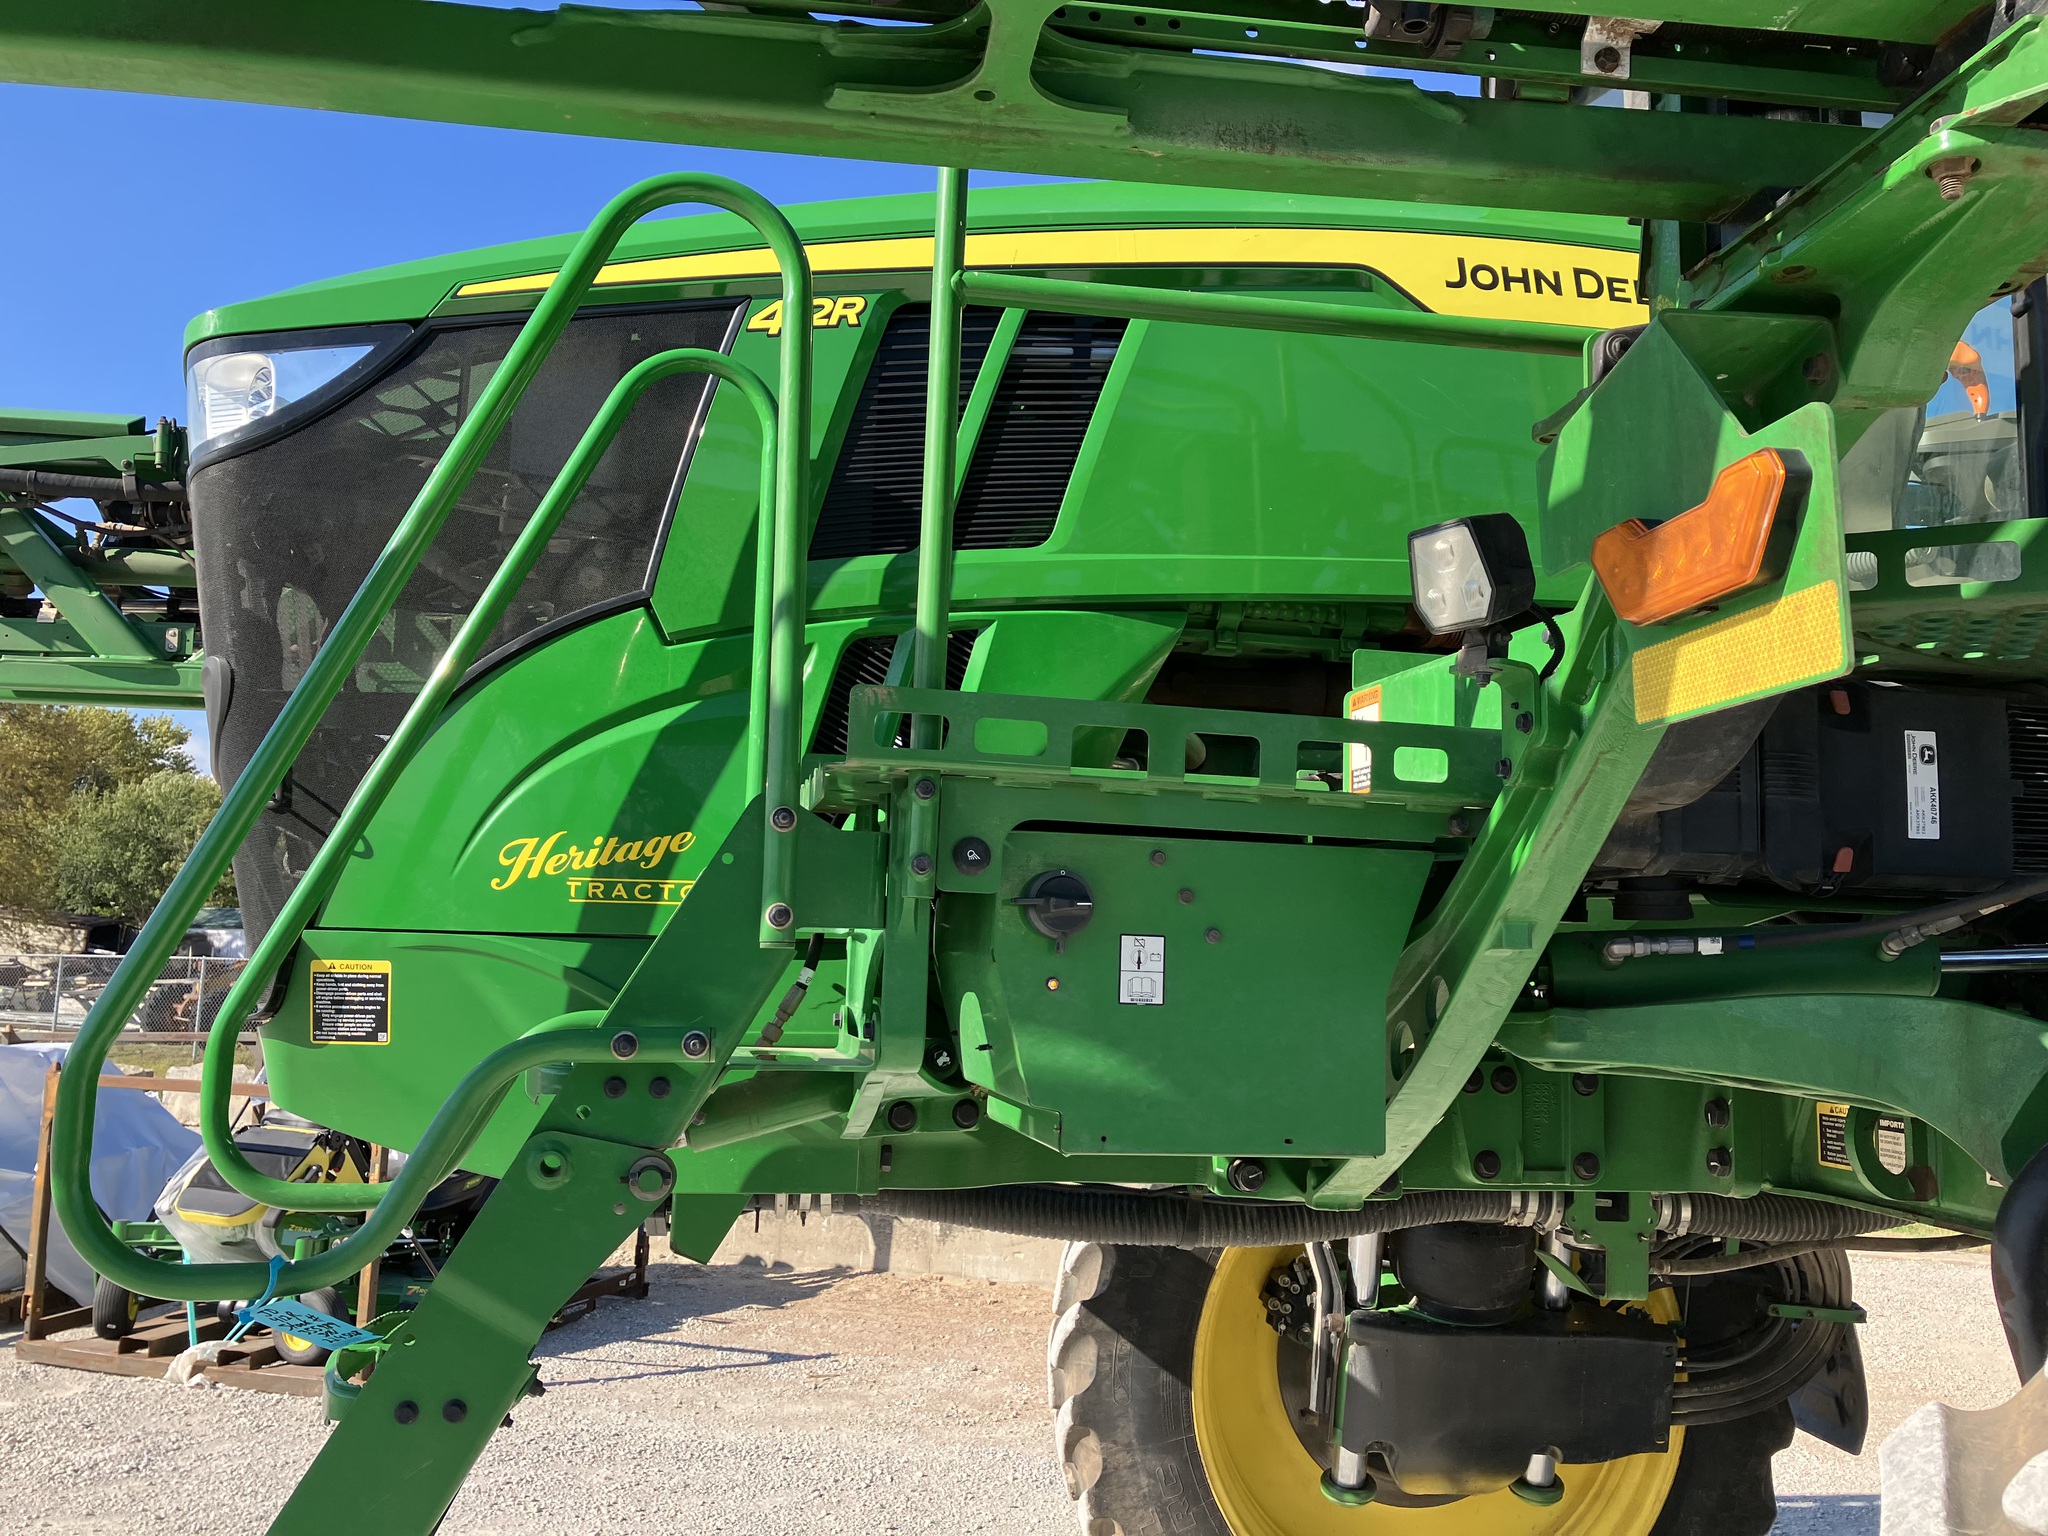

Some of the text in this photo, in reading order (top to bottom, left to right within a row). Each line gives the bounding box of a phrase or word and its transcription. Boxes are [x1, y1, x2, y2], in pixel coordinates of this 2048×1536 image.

[1445, 256, 1564, 297] JOHN
[746, 296, 868, 337] 42R
[1356, 690, 1378, 705] WARNING
[1929, 786, 1937, 825] AKK40746
[490, 830, 697, 891] Heritage
